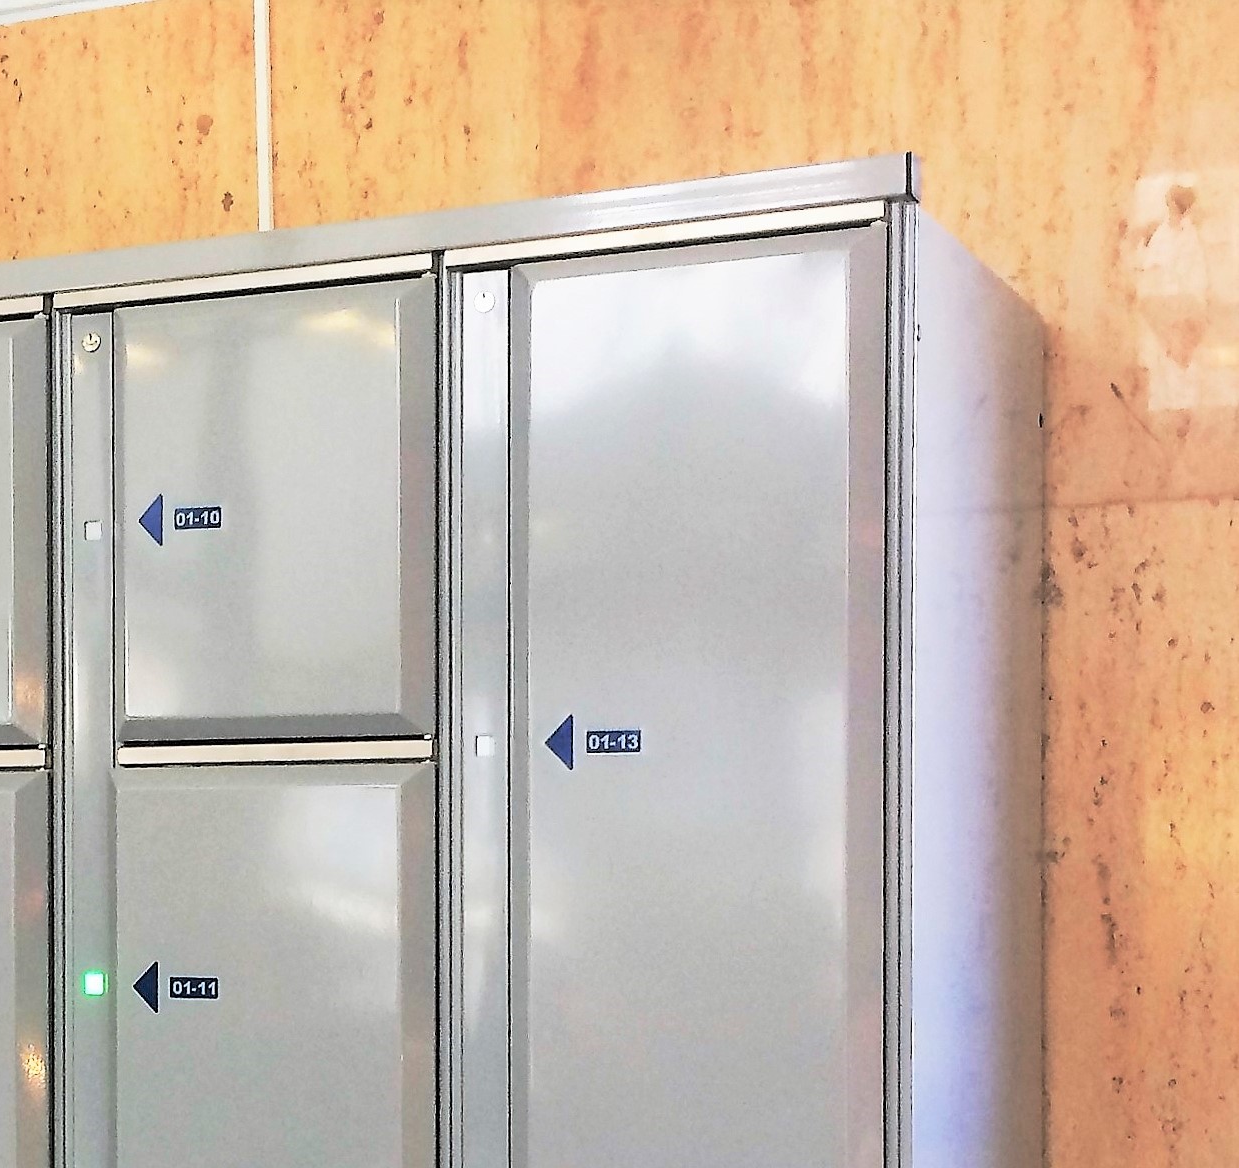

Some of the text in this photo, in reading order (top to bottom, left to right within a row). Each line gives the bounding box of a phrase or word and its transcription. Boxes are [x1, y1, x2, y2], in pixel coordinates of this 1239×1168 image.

[174, 511, 220, 526] 01-10
[588, 734, 638, 751] 01-13
[173, 981, 216, 995] 01-11
